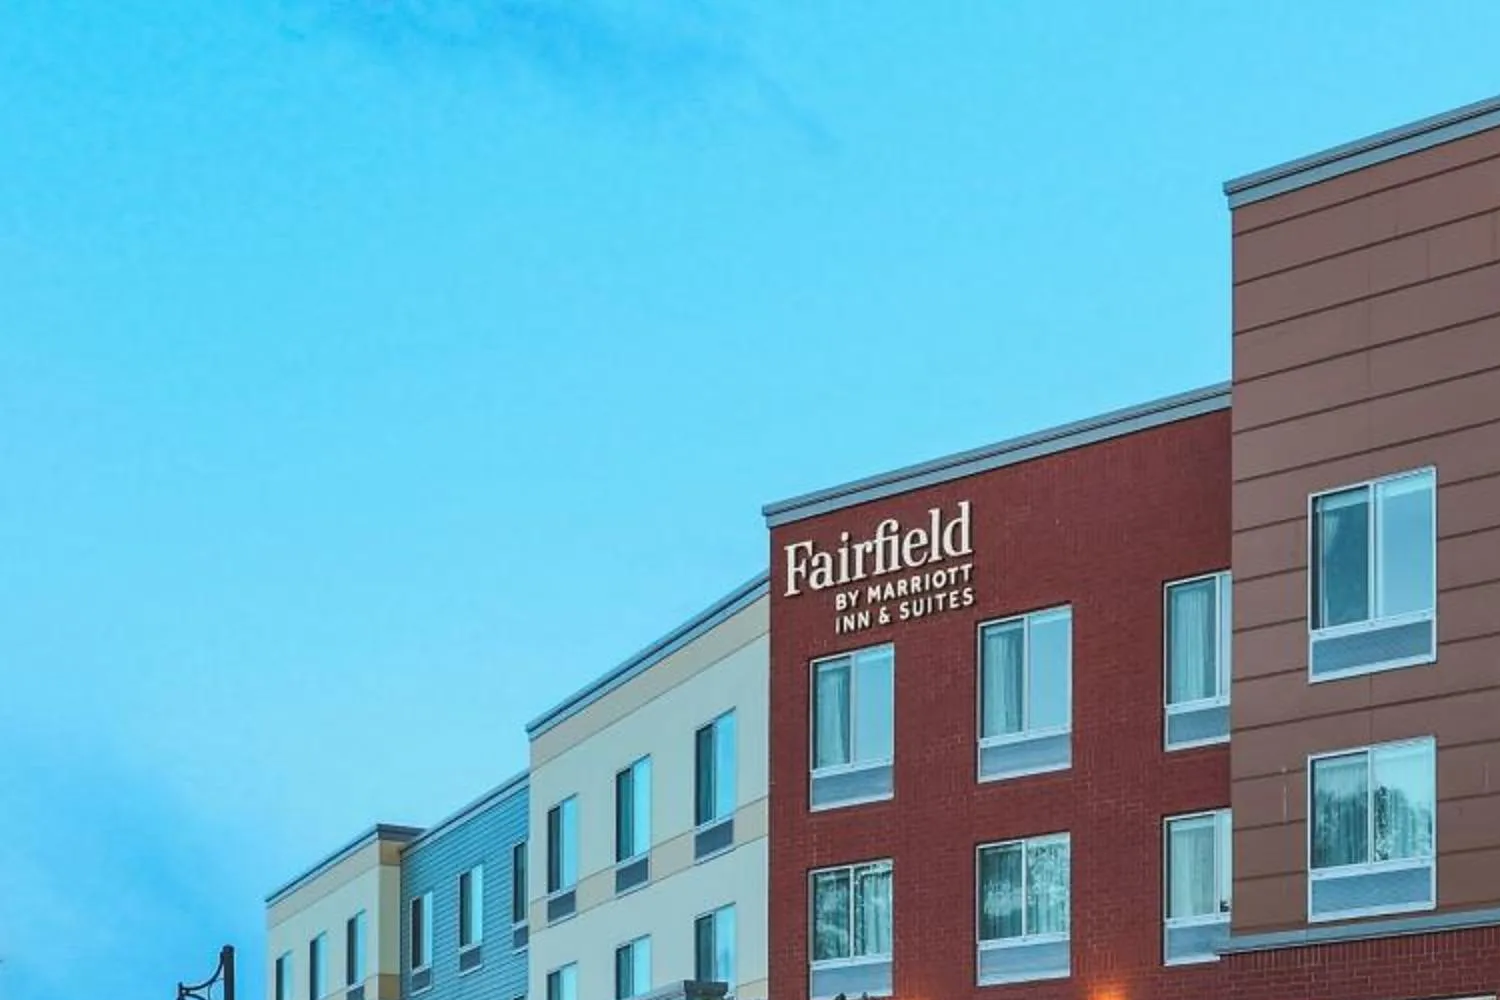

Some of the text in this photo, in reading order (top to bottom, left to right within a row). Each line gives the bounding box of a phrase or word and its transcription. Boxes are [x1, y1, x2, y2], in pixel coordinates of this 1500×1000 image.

[783, 501, 973, 597] Fairfield
[835, 563, 973, 611] BY MARRIOTT
[835, 587, 974, 634] INN & SUITES
